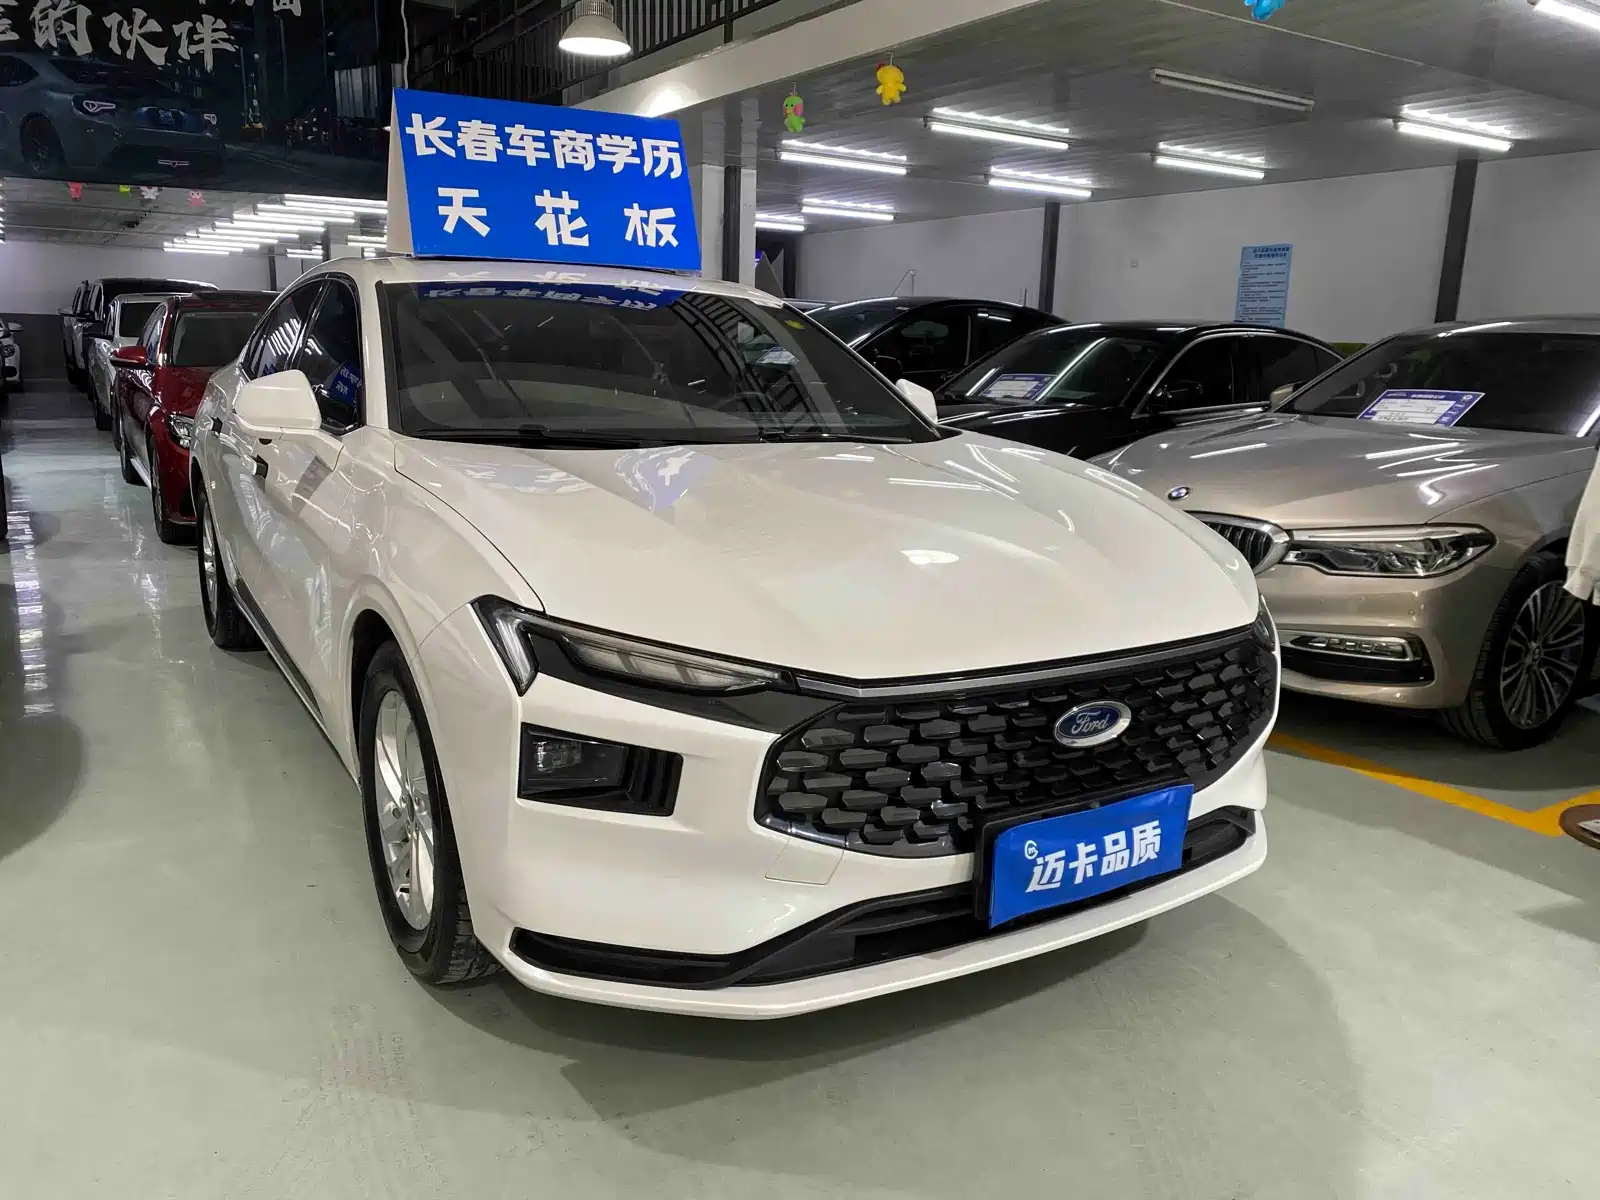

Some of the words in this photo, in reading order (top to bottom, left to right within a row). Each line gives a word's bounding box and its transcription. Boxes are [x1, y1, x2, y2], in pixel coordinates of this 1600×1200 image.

[405, 113, 683, 179] 长春车商学历
[437, 187, 679, 247] 天花板
[1071, 711, 1110, 734] Ford
[1025, 820, 1162, 893] 迈卡品质
